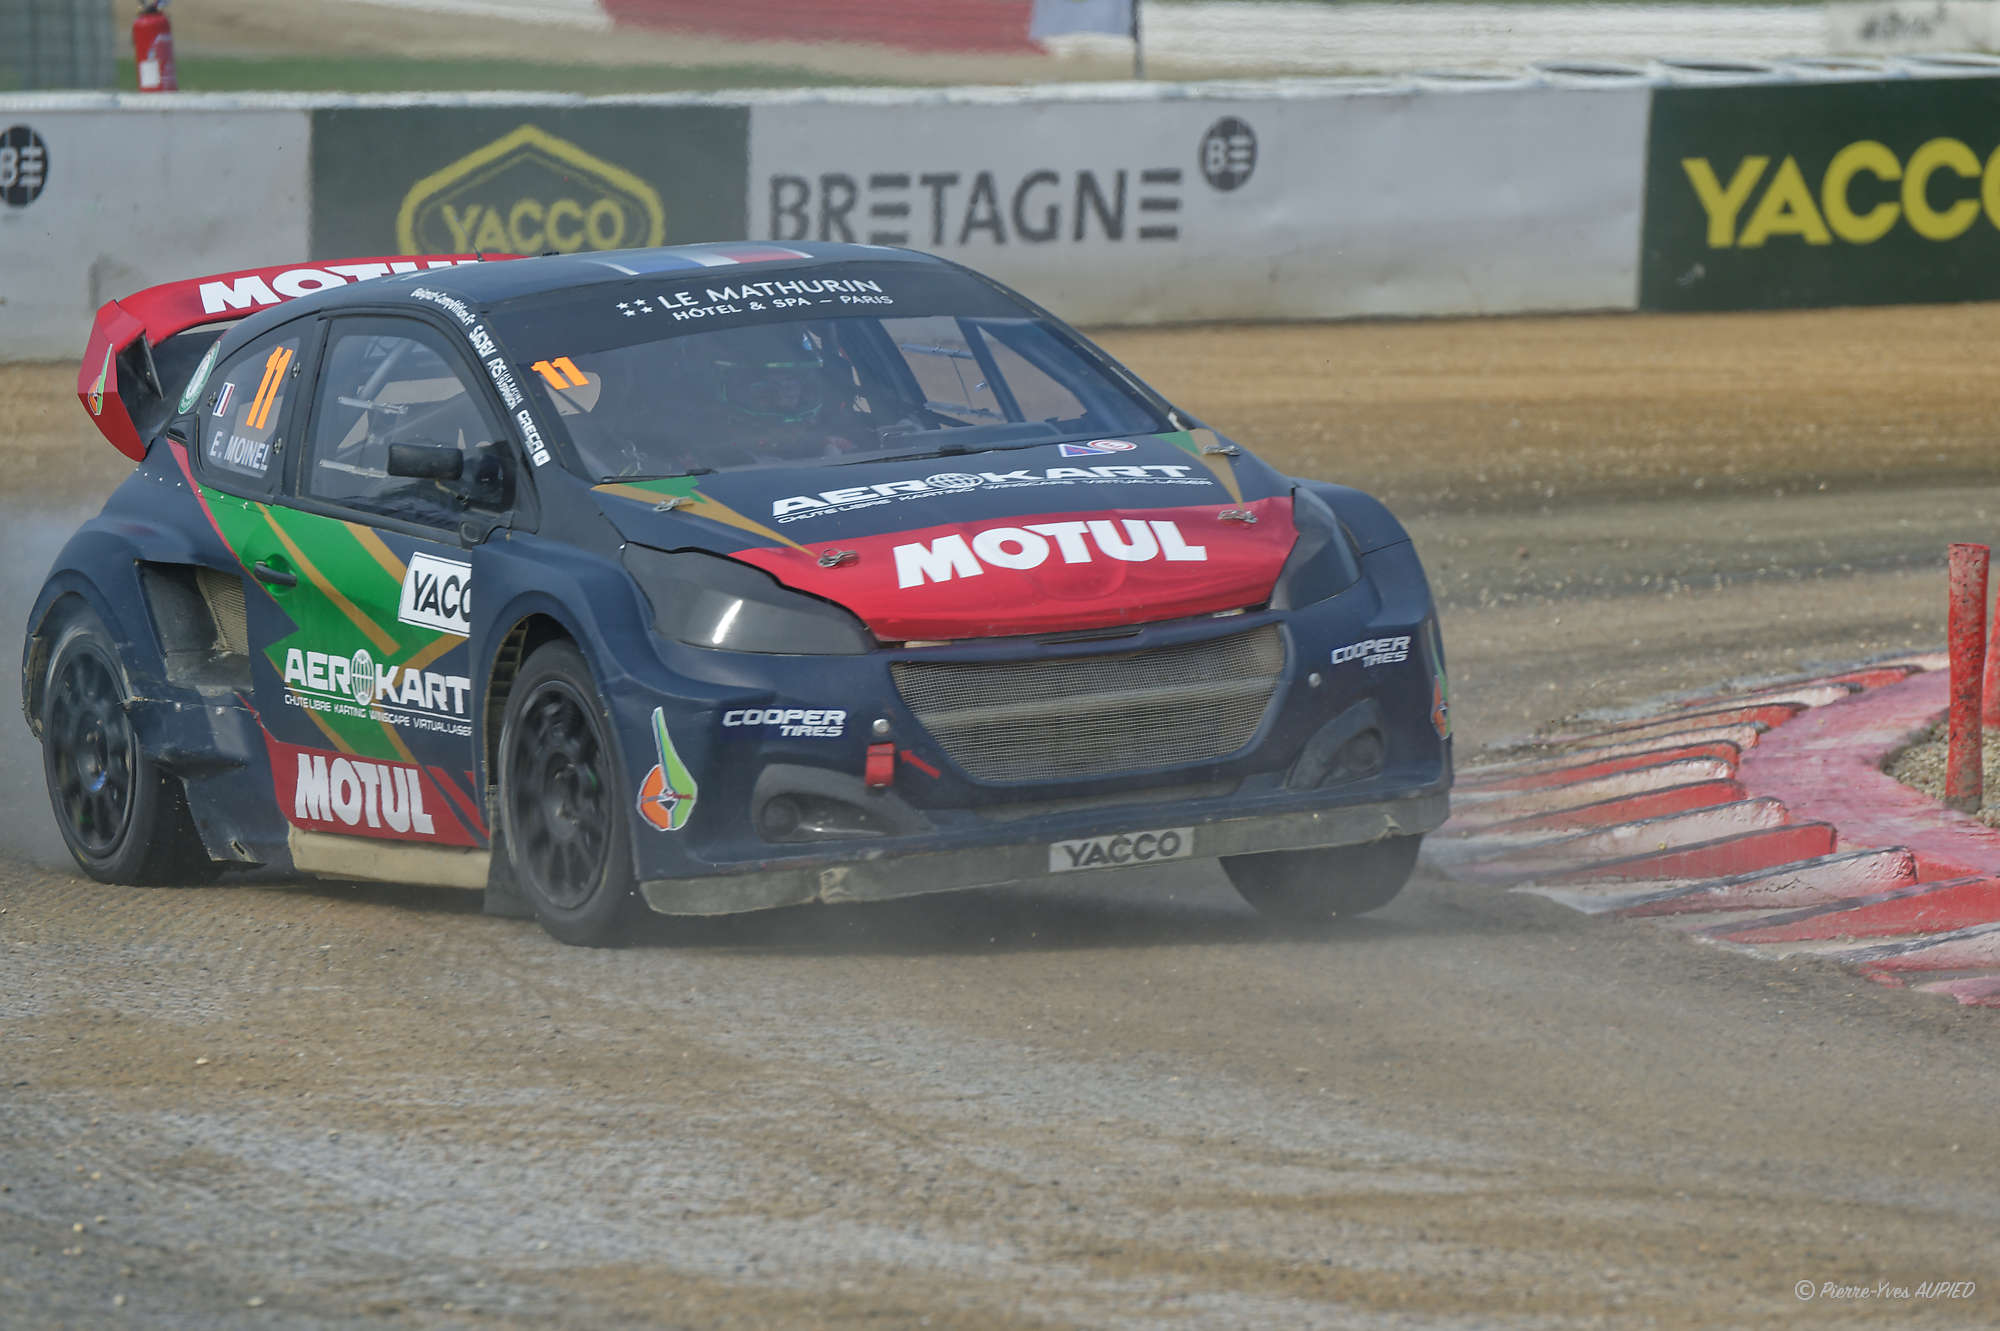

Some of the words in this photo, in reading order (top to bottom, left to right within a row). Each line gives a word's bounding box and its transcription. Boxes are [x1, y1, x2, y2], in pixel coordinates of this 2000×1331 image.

[769, 168, 1183, 246] BRETAGNE
[1681, 137, 2000, 248] YACC
[441, 198, 625, 254] YACCO
[199, 260, 484, 314] MOT
[657, 291, 699, 309] LE
[706, 279, 883, 303] MATHURIN
[750, 301, 766, 311] &
[776, 297, 811, 309] SPA
[839, 295, 893, 305] PARIS
[245, 346, 294, 430] 11
[530, 356, 590, 390] 11
[224, 435, 270, 471] MOINEL
[892, 519, 1207, 589] MOTUL
[1331, 636, 1411, 665] COOPER
[1362, 650, 1408, 668] TIRES
[284, 694, 308, 708] CHUTE
[334, 703, 366, 718] KARTING
[722, 709, 847, 727] COOPER
[780, 725, 843, 737] TIRES
[295, 753, 435, 834] MOTUL
[1062, 831, 1182, 867] YACCO
